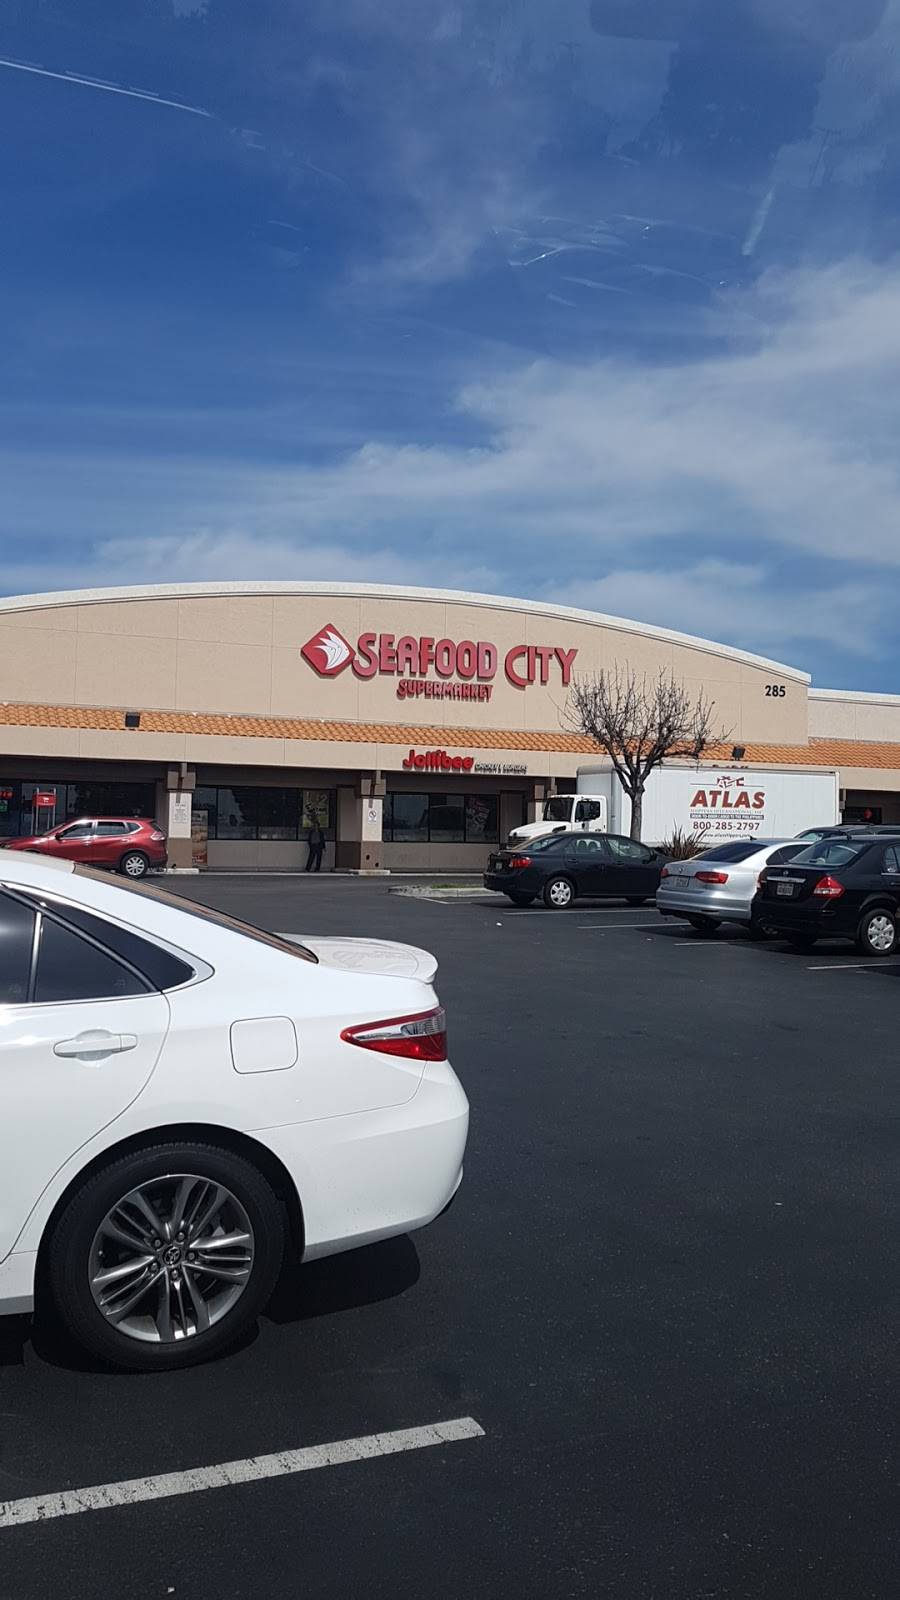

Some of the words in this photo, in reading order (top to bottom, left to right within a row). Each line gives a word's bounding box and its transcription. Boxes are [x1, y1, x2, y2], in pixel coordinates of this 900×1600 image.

[352, 633, 497, 679] SEAFOOD
[504, 644, 578, 688] CITY
[397, 679, 493, 701] SUPERMARKET
[764, 684, 786, 698] 285
[402, 749, 474, 771] Jollibee
[690, 789, 765, 809] ATLAS
[693, 821, 760, 831] 800-285-2797
